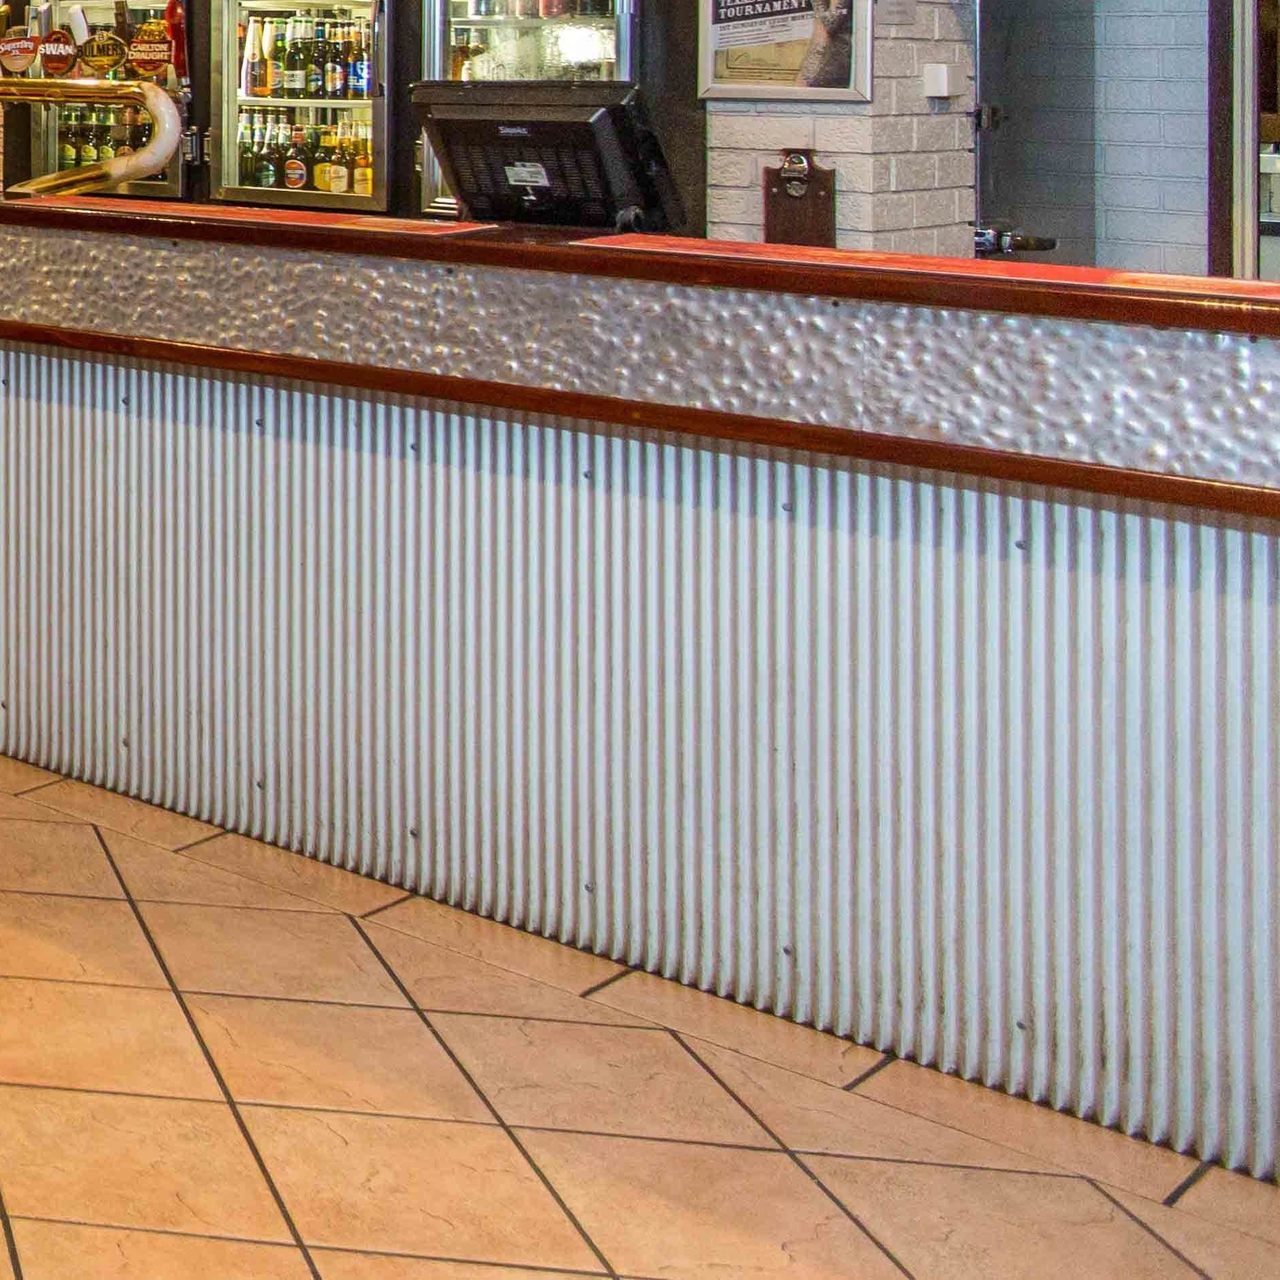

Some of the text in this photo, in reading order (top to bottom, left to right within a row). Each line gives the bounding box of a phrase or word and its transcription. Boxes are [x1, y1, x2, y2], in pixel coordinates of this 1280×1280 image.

[39, 43, 74, 56] SWAN
[130, 43, 169, 52] CARLTON
[128, 52, 170, 61] DRAUGHT
